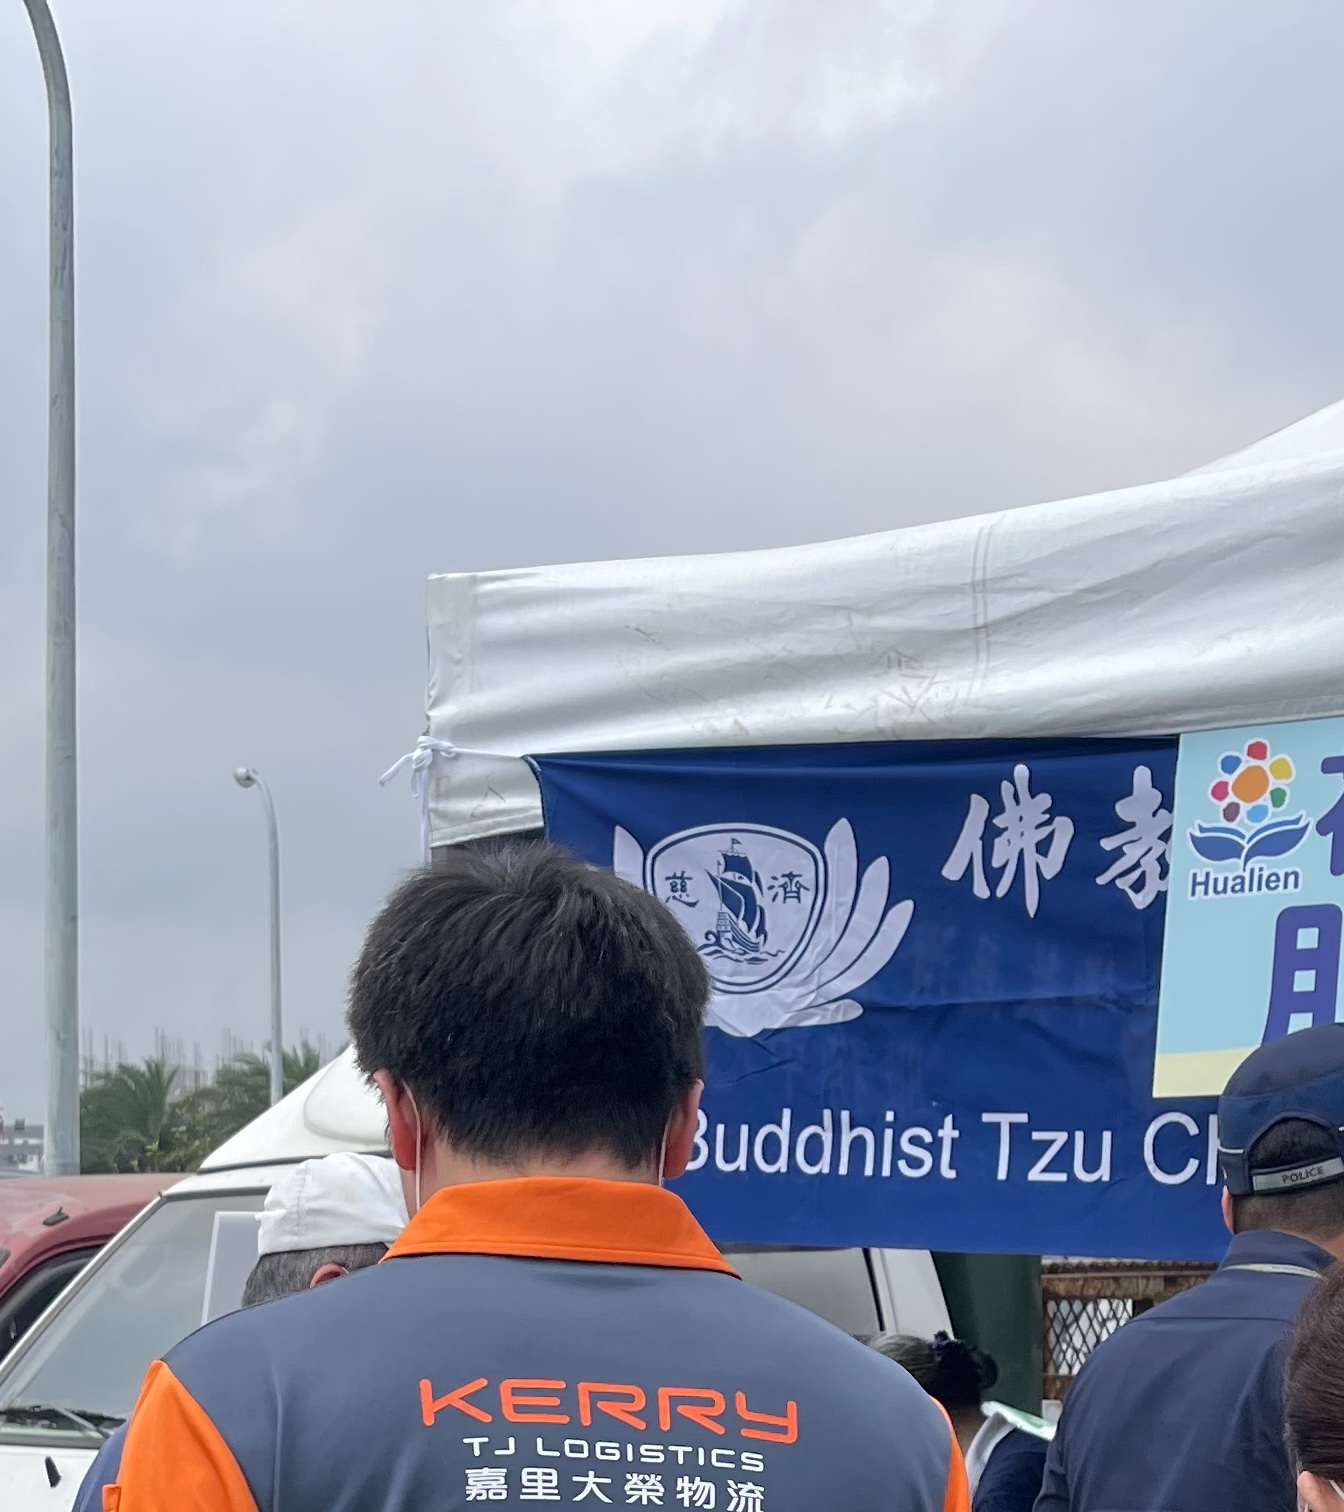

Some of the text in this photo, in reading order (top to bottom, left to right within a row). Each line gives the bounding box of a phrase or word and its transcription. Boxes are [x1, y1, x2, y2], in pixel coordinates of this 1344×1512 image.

[1189, 866, 1301, 898] Hualien
[982, 1111, 1113, 1183] Tzu
[1281, 1165, 1324, 1184] POLICE
[418, 1376, 798, 1445] KERRY
[463, 1436, 765, 1473] TJ LOGISTICS
